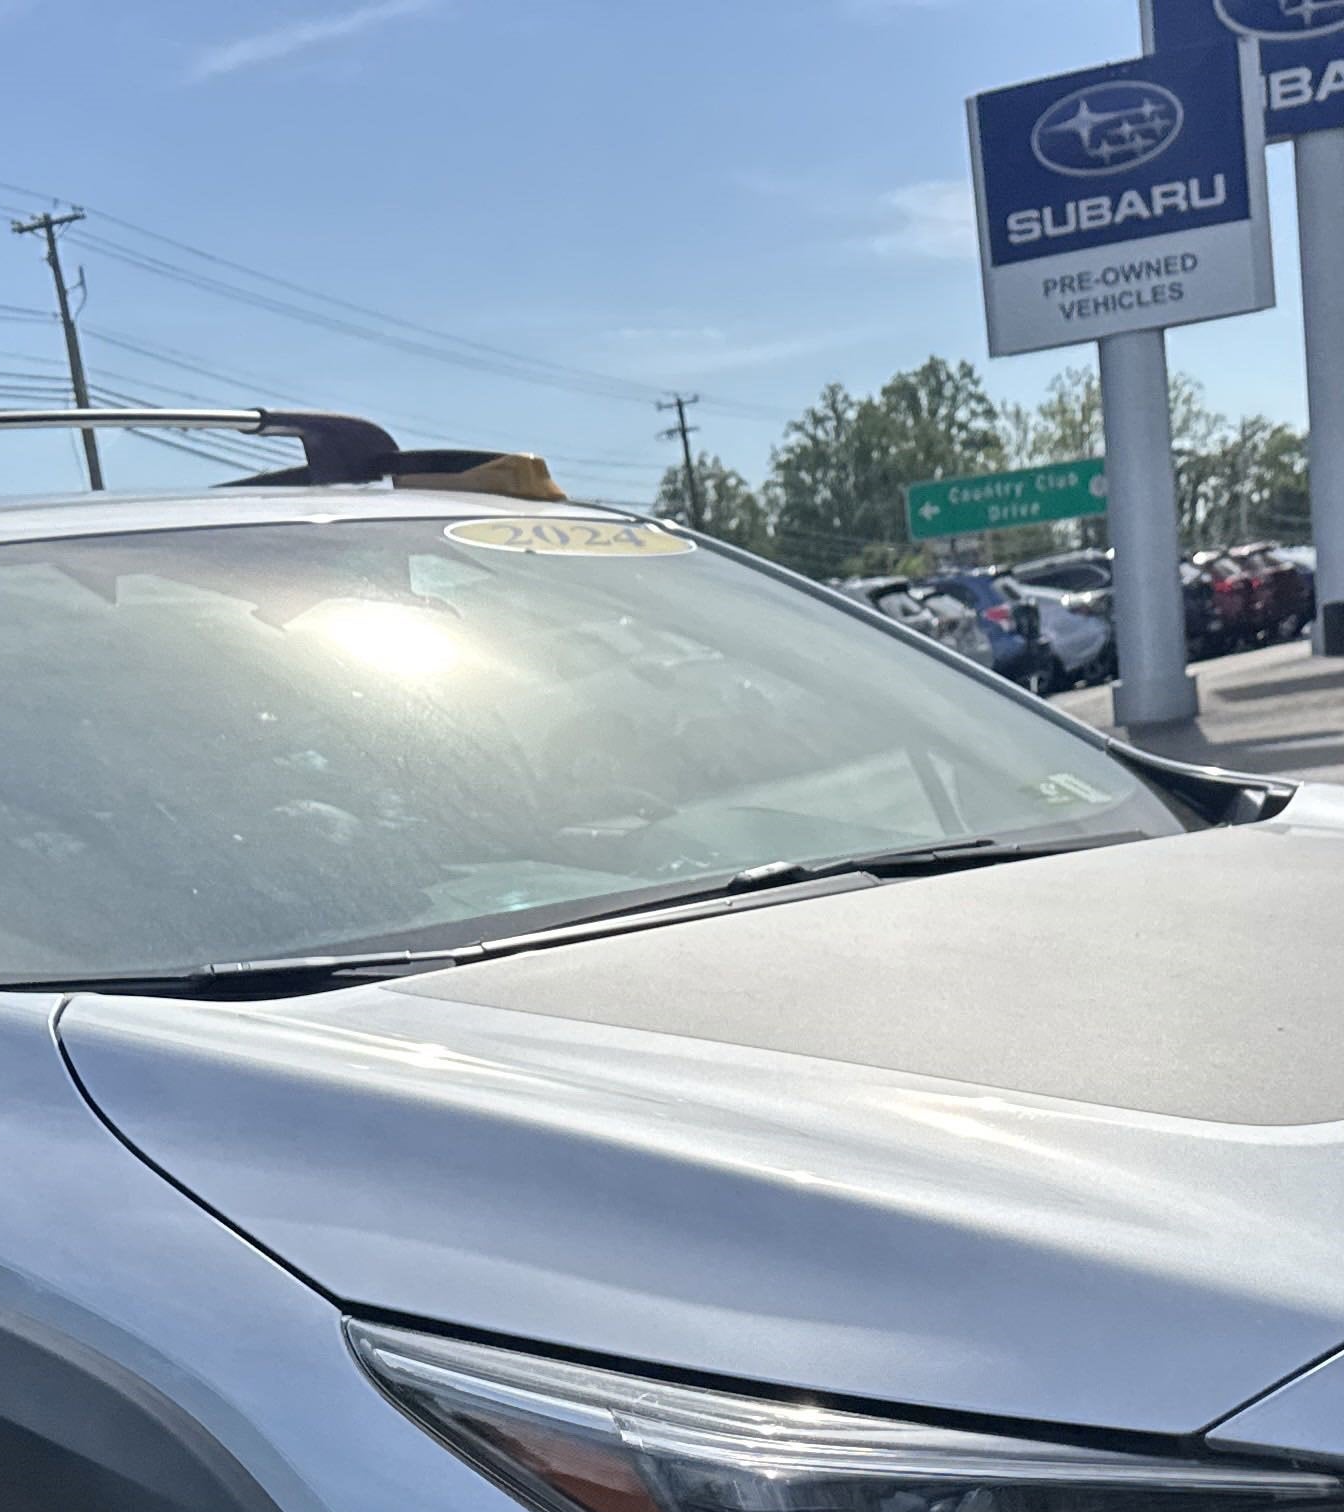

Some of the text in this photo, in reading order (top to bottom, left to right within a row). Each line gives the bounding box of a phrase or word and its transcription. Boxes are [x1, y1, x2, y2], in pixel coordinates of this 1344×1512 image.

[1006, 174, 1227, 244] SUBARU
[1043, 252, 1199, 297] PRE-OWNED
[1058, 282, 1185, 321] VEHICLES
[949, 471, 1079, 504] Country Club
[988, 502, 1041, 522] Drive
[493, 524, 644, 547] 2024
